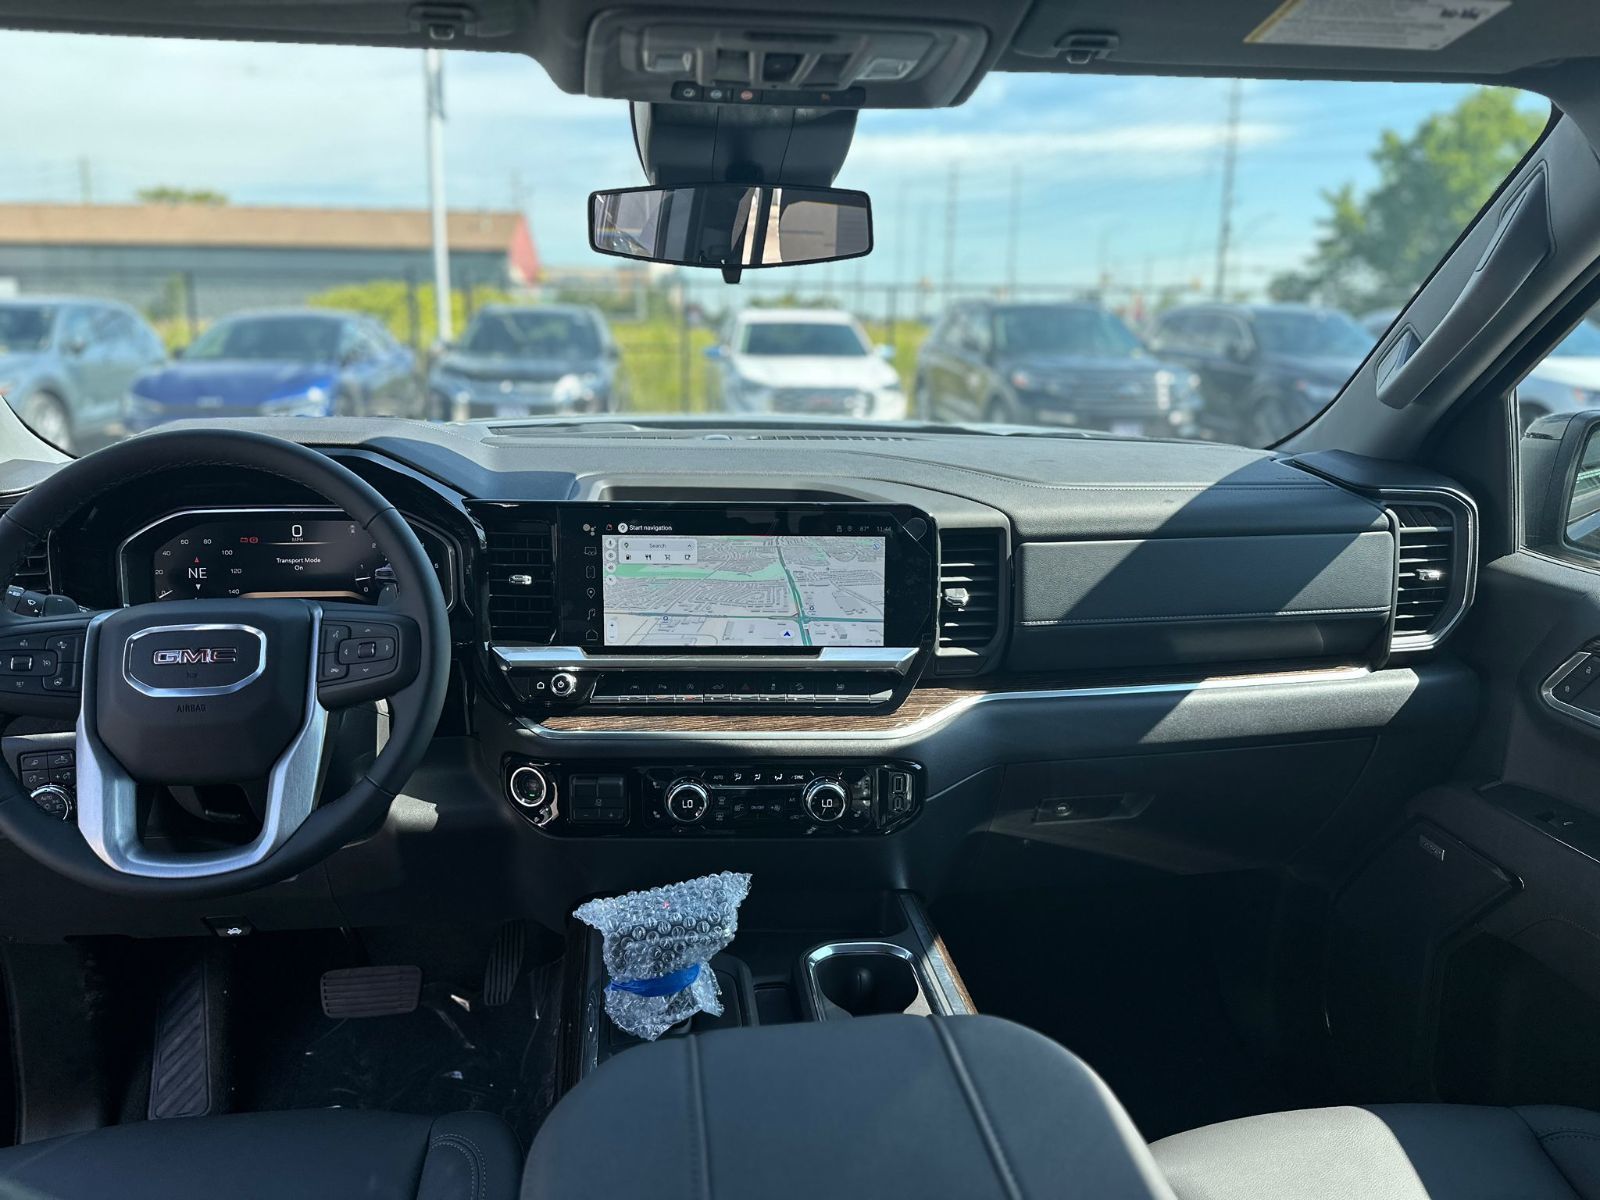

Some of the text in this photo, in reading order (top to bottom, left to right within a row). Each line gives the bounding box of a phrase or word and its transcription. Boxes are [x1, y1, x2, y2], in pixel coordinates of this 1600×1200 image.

[291, 524, 303, 538] 0
[276, 557, 304, 565] Transport
[187, 567, 208, 579] NE
[153, 648, 238, 665] GMC
[176, 704, 207, 713] AIRBAG
[681, 799, 694, 809] LO
[821, 798, 833, 808] LO
